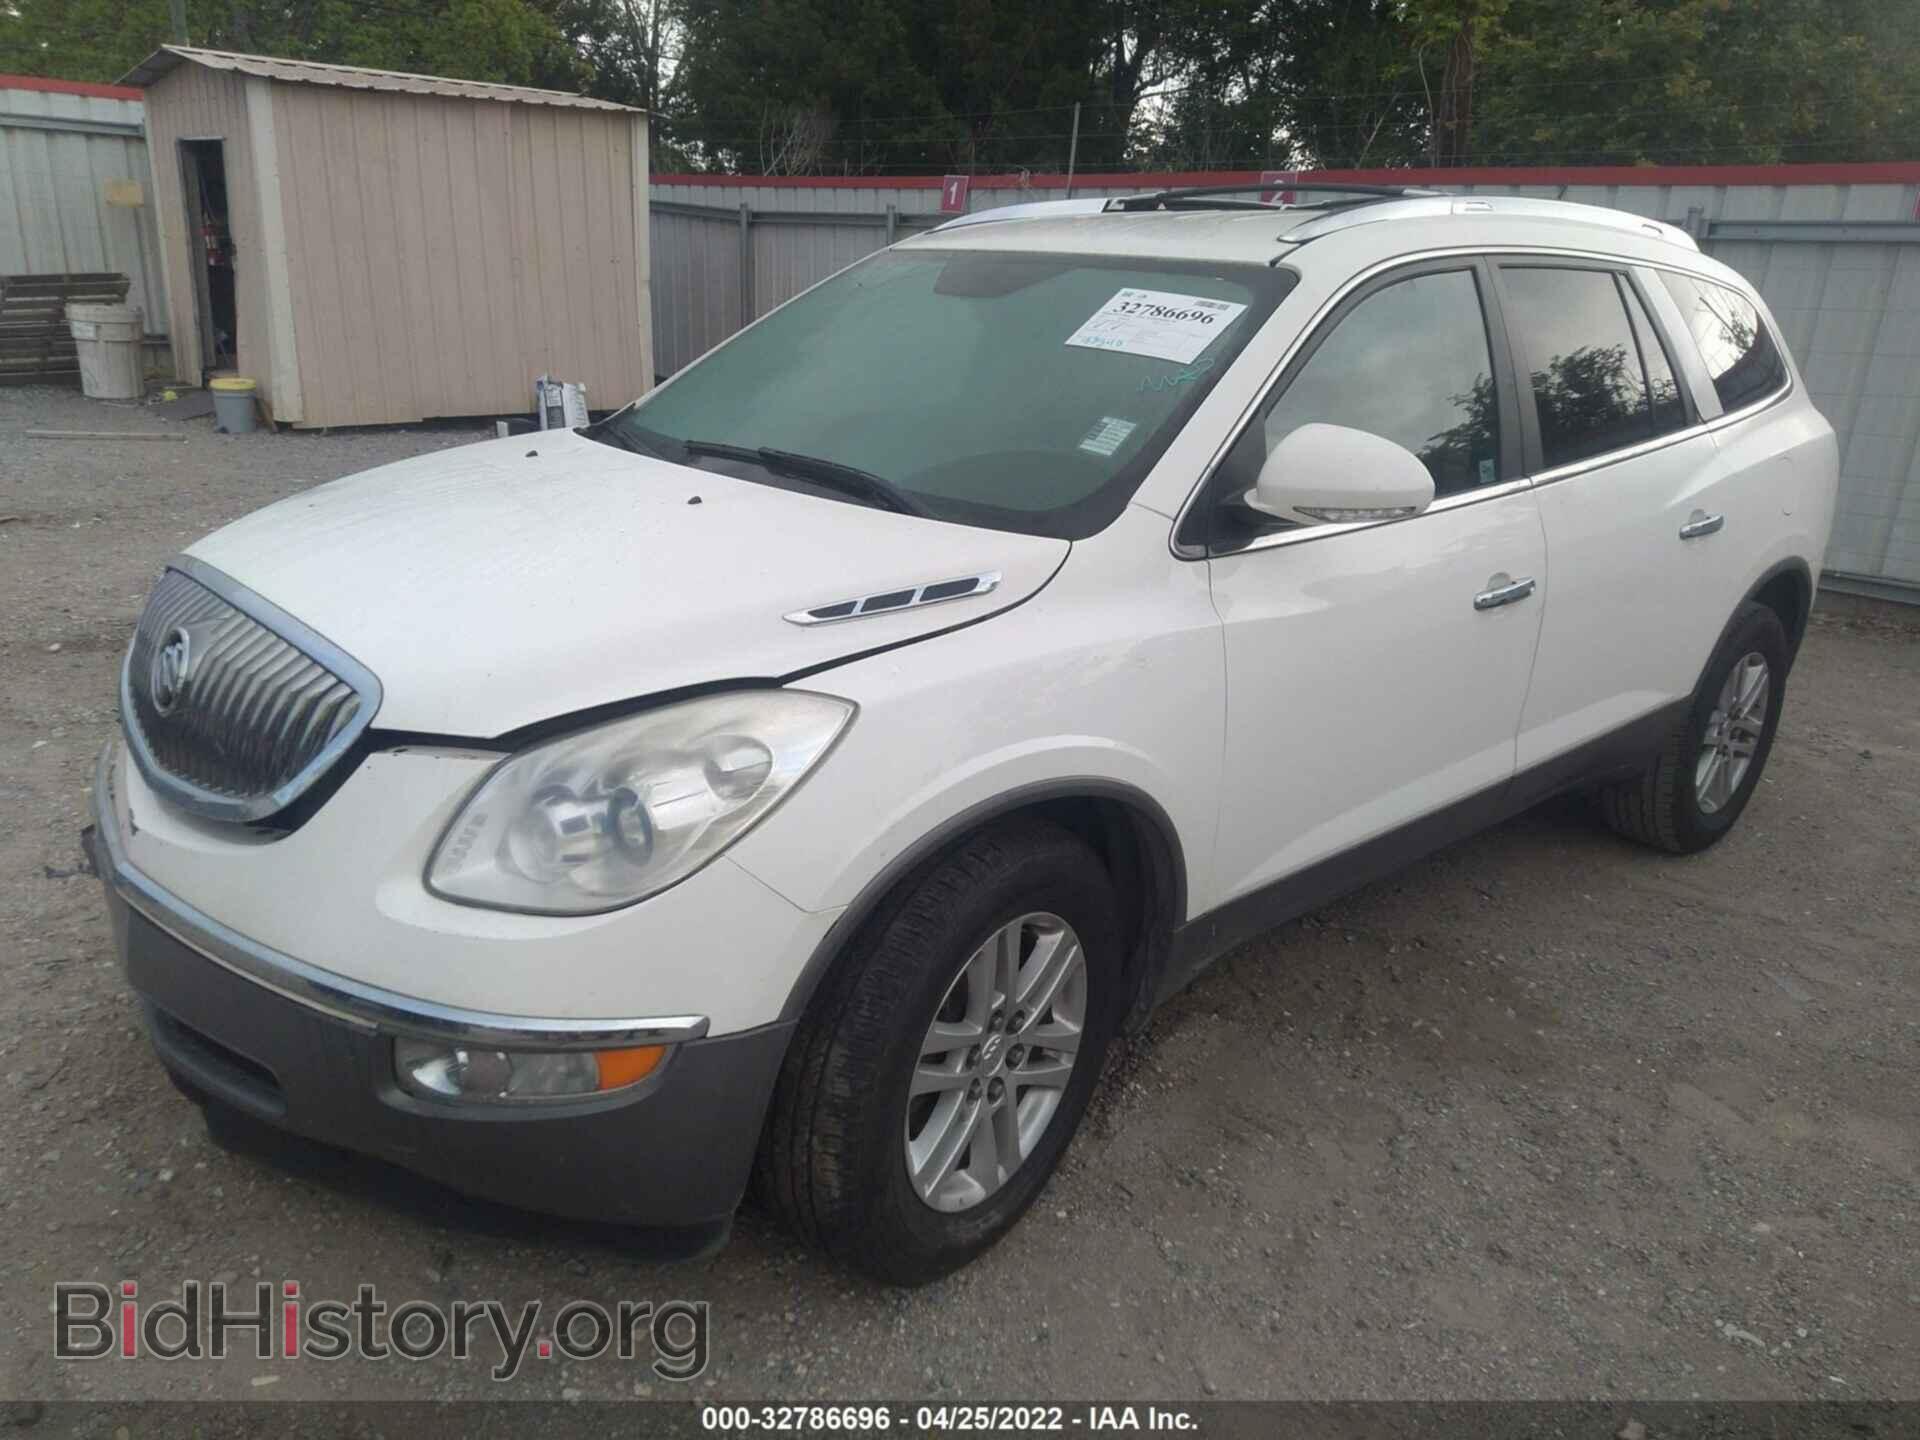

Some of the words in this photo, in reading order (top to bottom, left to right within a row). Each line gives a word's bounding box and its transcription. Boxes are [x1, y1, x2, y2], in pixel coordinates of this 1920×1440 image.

[950, 181, 958, 205] 1
[1270, 179, 1285, 206] 2
[1112, 301, 1215, 325] 32786696
